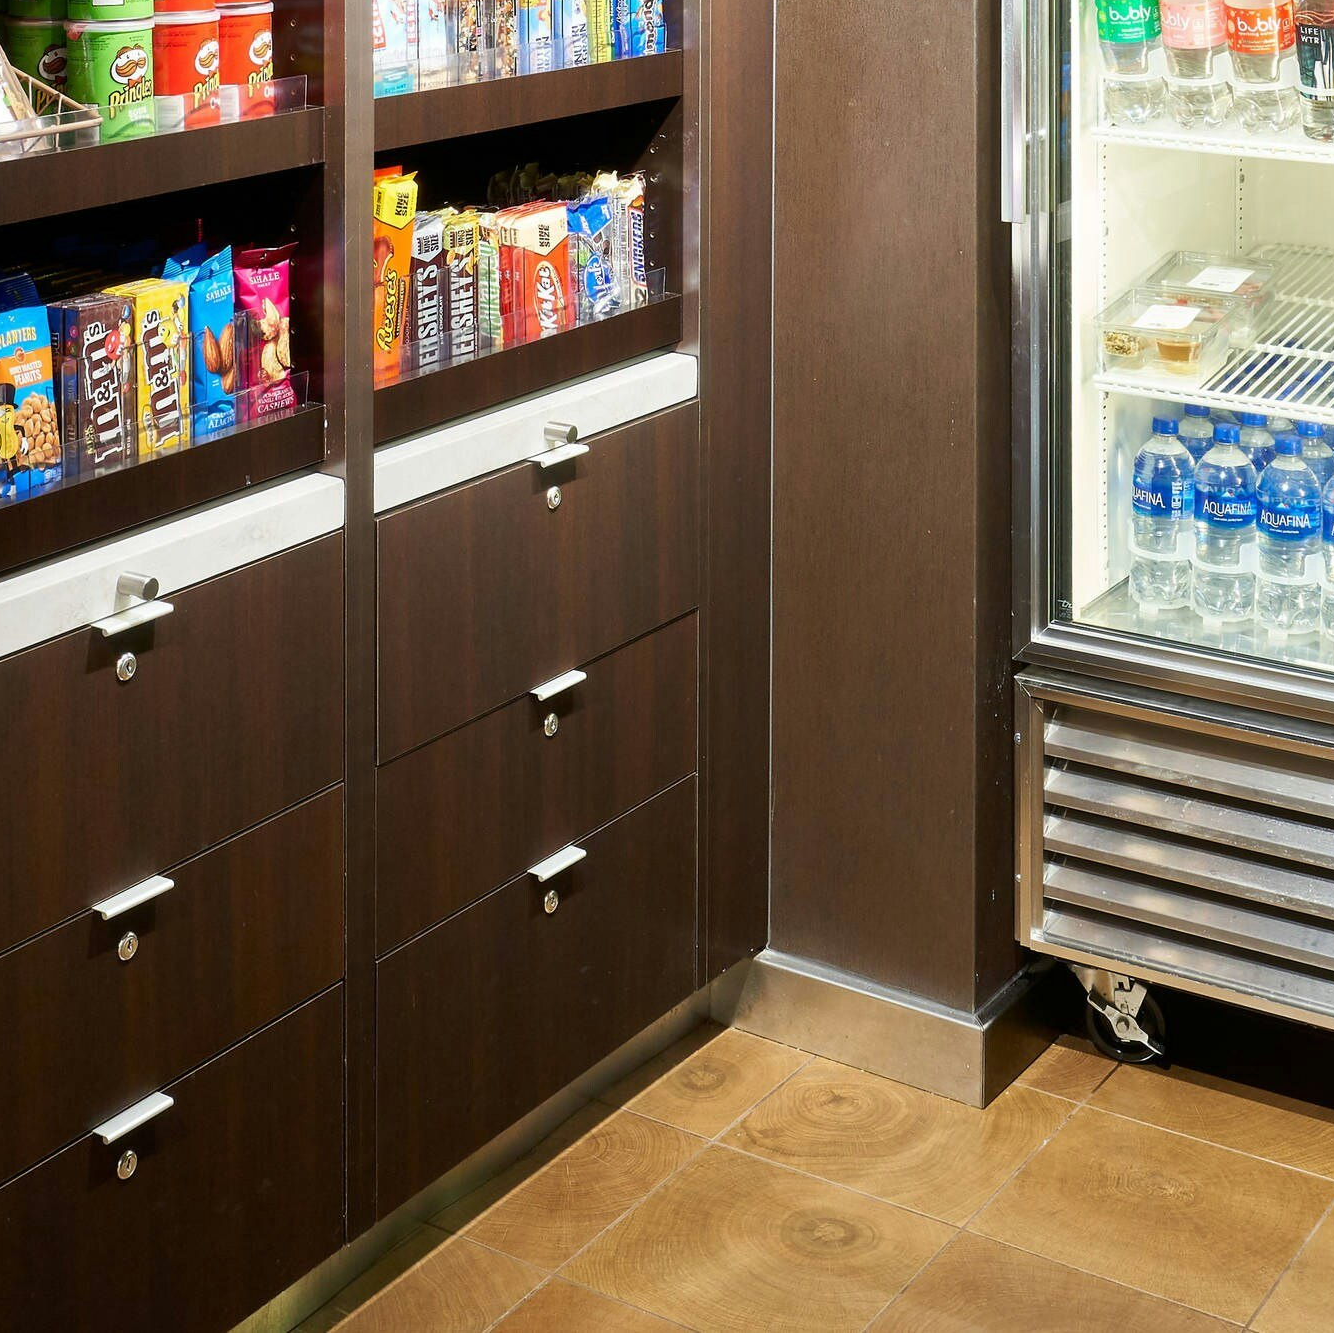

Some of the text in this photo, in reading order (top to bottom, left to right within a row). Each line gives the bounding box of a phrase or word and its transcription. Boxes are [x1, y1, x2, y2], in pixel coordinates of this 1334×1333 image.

[1109, 5, 1152, 23] bubly
[1237, 16, 1282, 34] bubly
[1300, 26, 1319, 36] LIFE
[1300, 35, 1320, 45] WTR
[108, 74, 154, 120] Pringles
[395, 192, 403, 216] KING
[430, 234, 439, 252] SIZE
[464, 227, 474, 246] SIZE
[248, 271, 280, 285] SAHALE
[205, 285, 232, 303] SAHALE
[376, 268, 398, 351] Reese's
[13, 368, 43, 387] PEANUTS
[257, 397, 296, 414] CASHEWS
[1202, 498, 1252, 521] AQUAFINA
[1260, 508, 1310, 530] AQUAFINA
